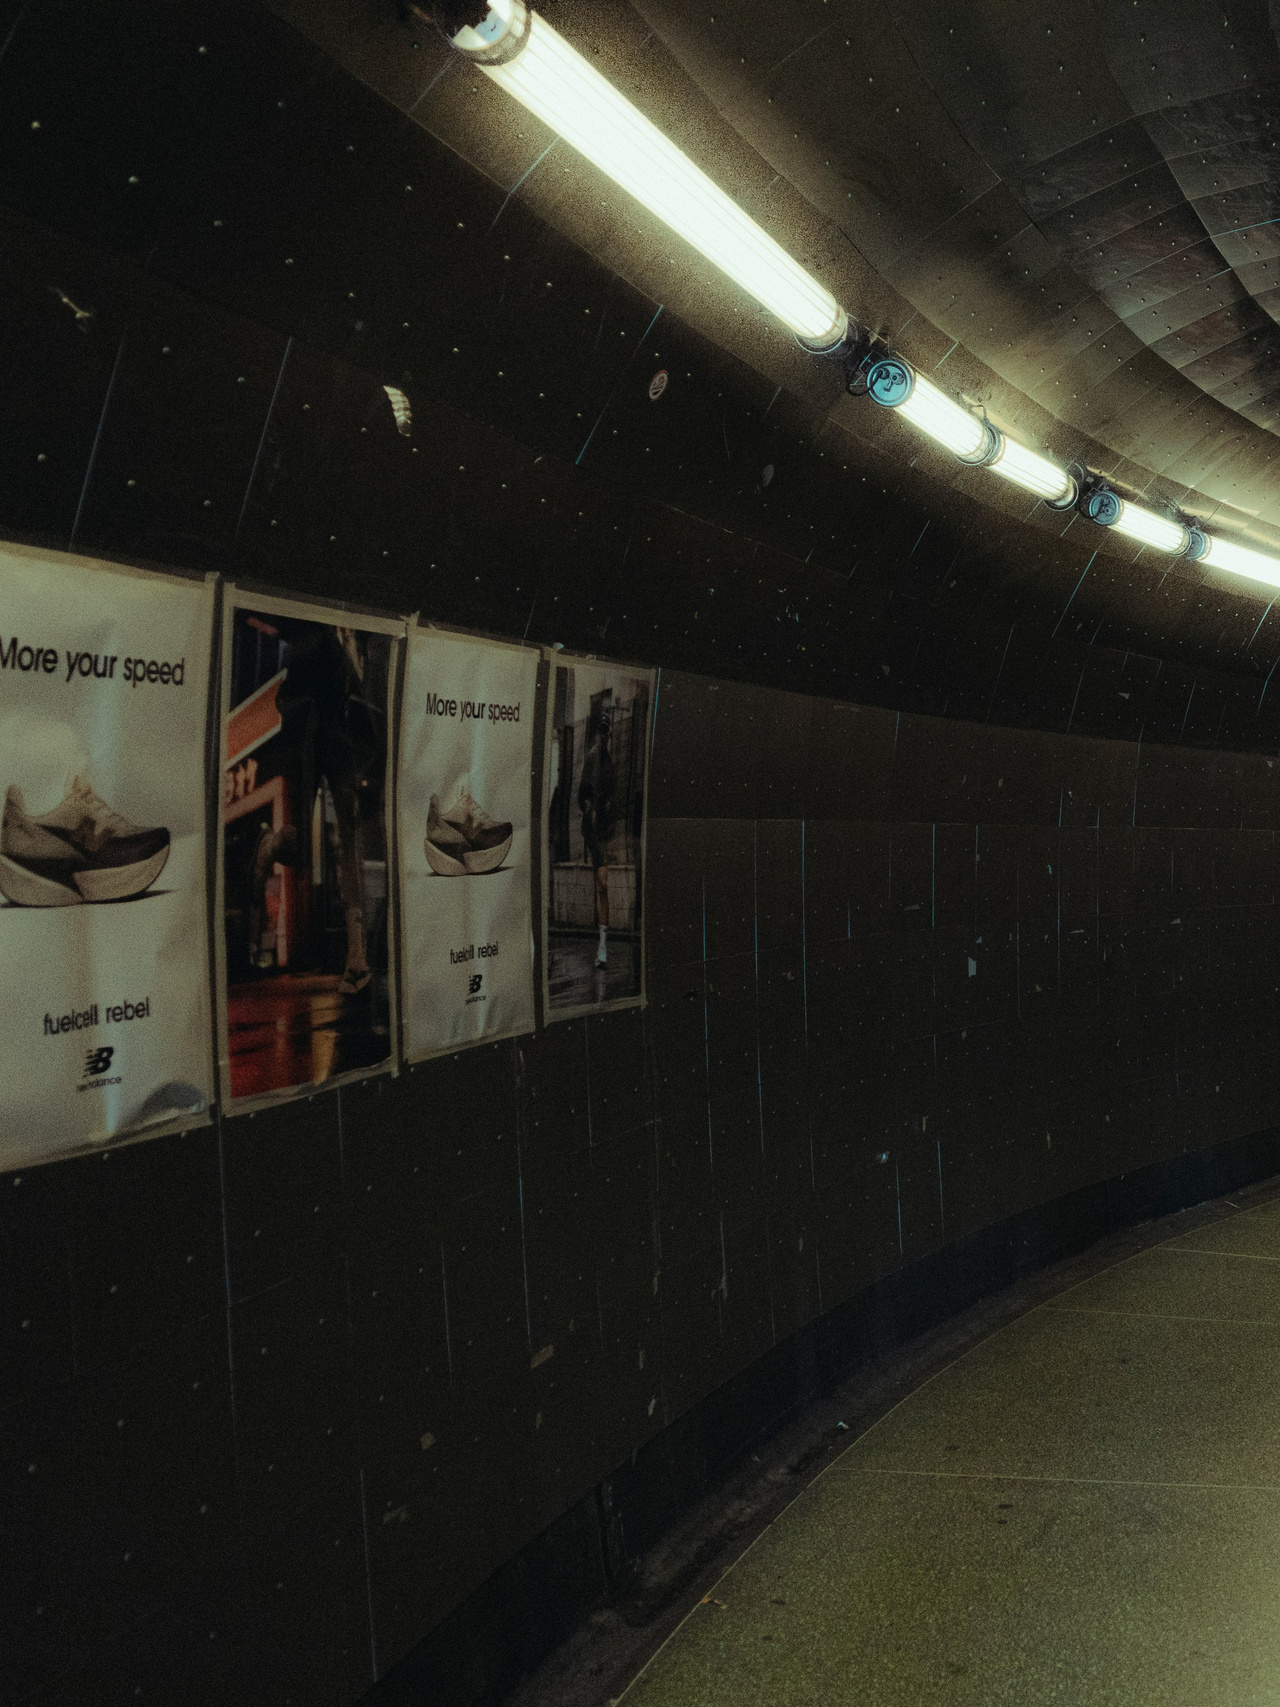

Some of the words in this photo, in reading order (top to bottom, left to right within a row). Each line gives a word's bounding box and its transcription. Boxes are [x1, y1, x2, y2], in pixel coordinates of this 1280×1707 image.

[0, 636, 58, 673] More
[65, 650, 118, 682] your
[123, 657, 186, 688] speed
[425, 692, 457, 717] More
[460, 700, 486, 723] your
[488, 702, 521, 725] speed
[477, 940, 499, 959] rebel
[43, 1004, 99, 1036] fuelcell
[105, 996, 151, 1024] rebel
